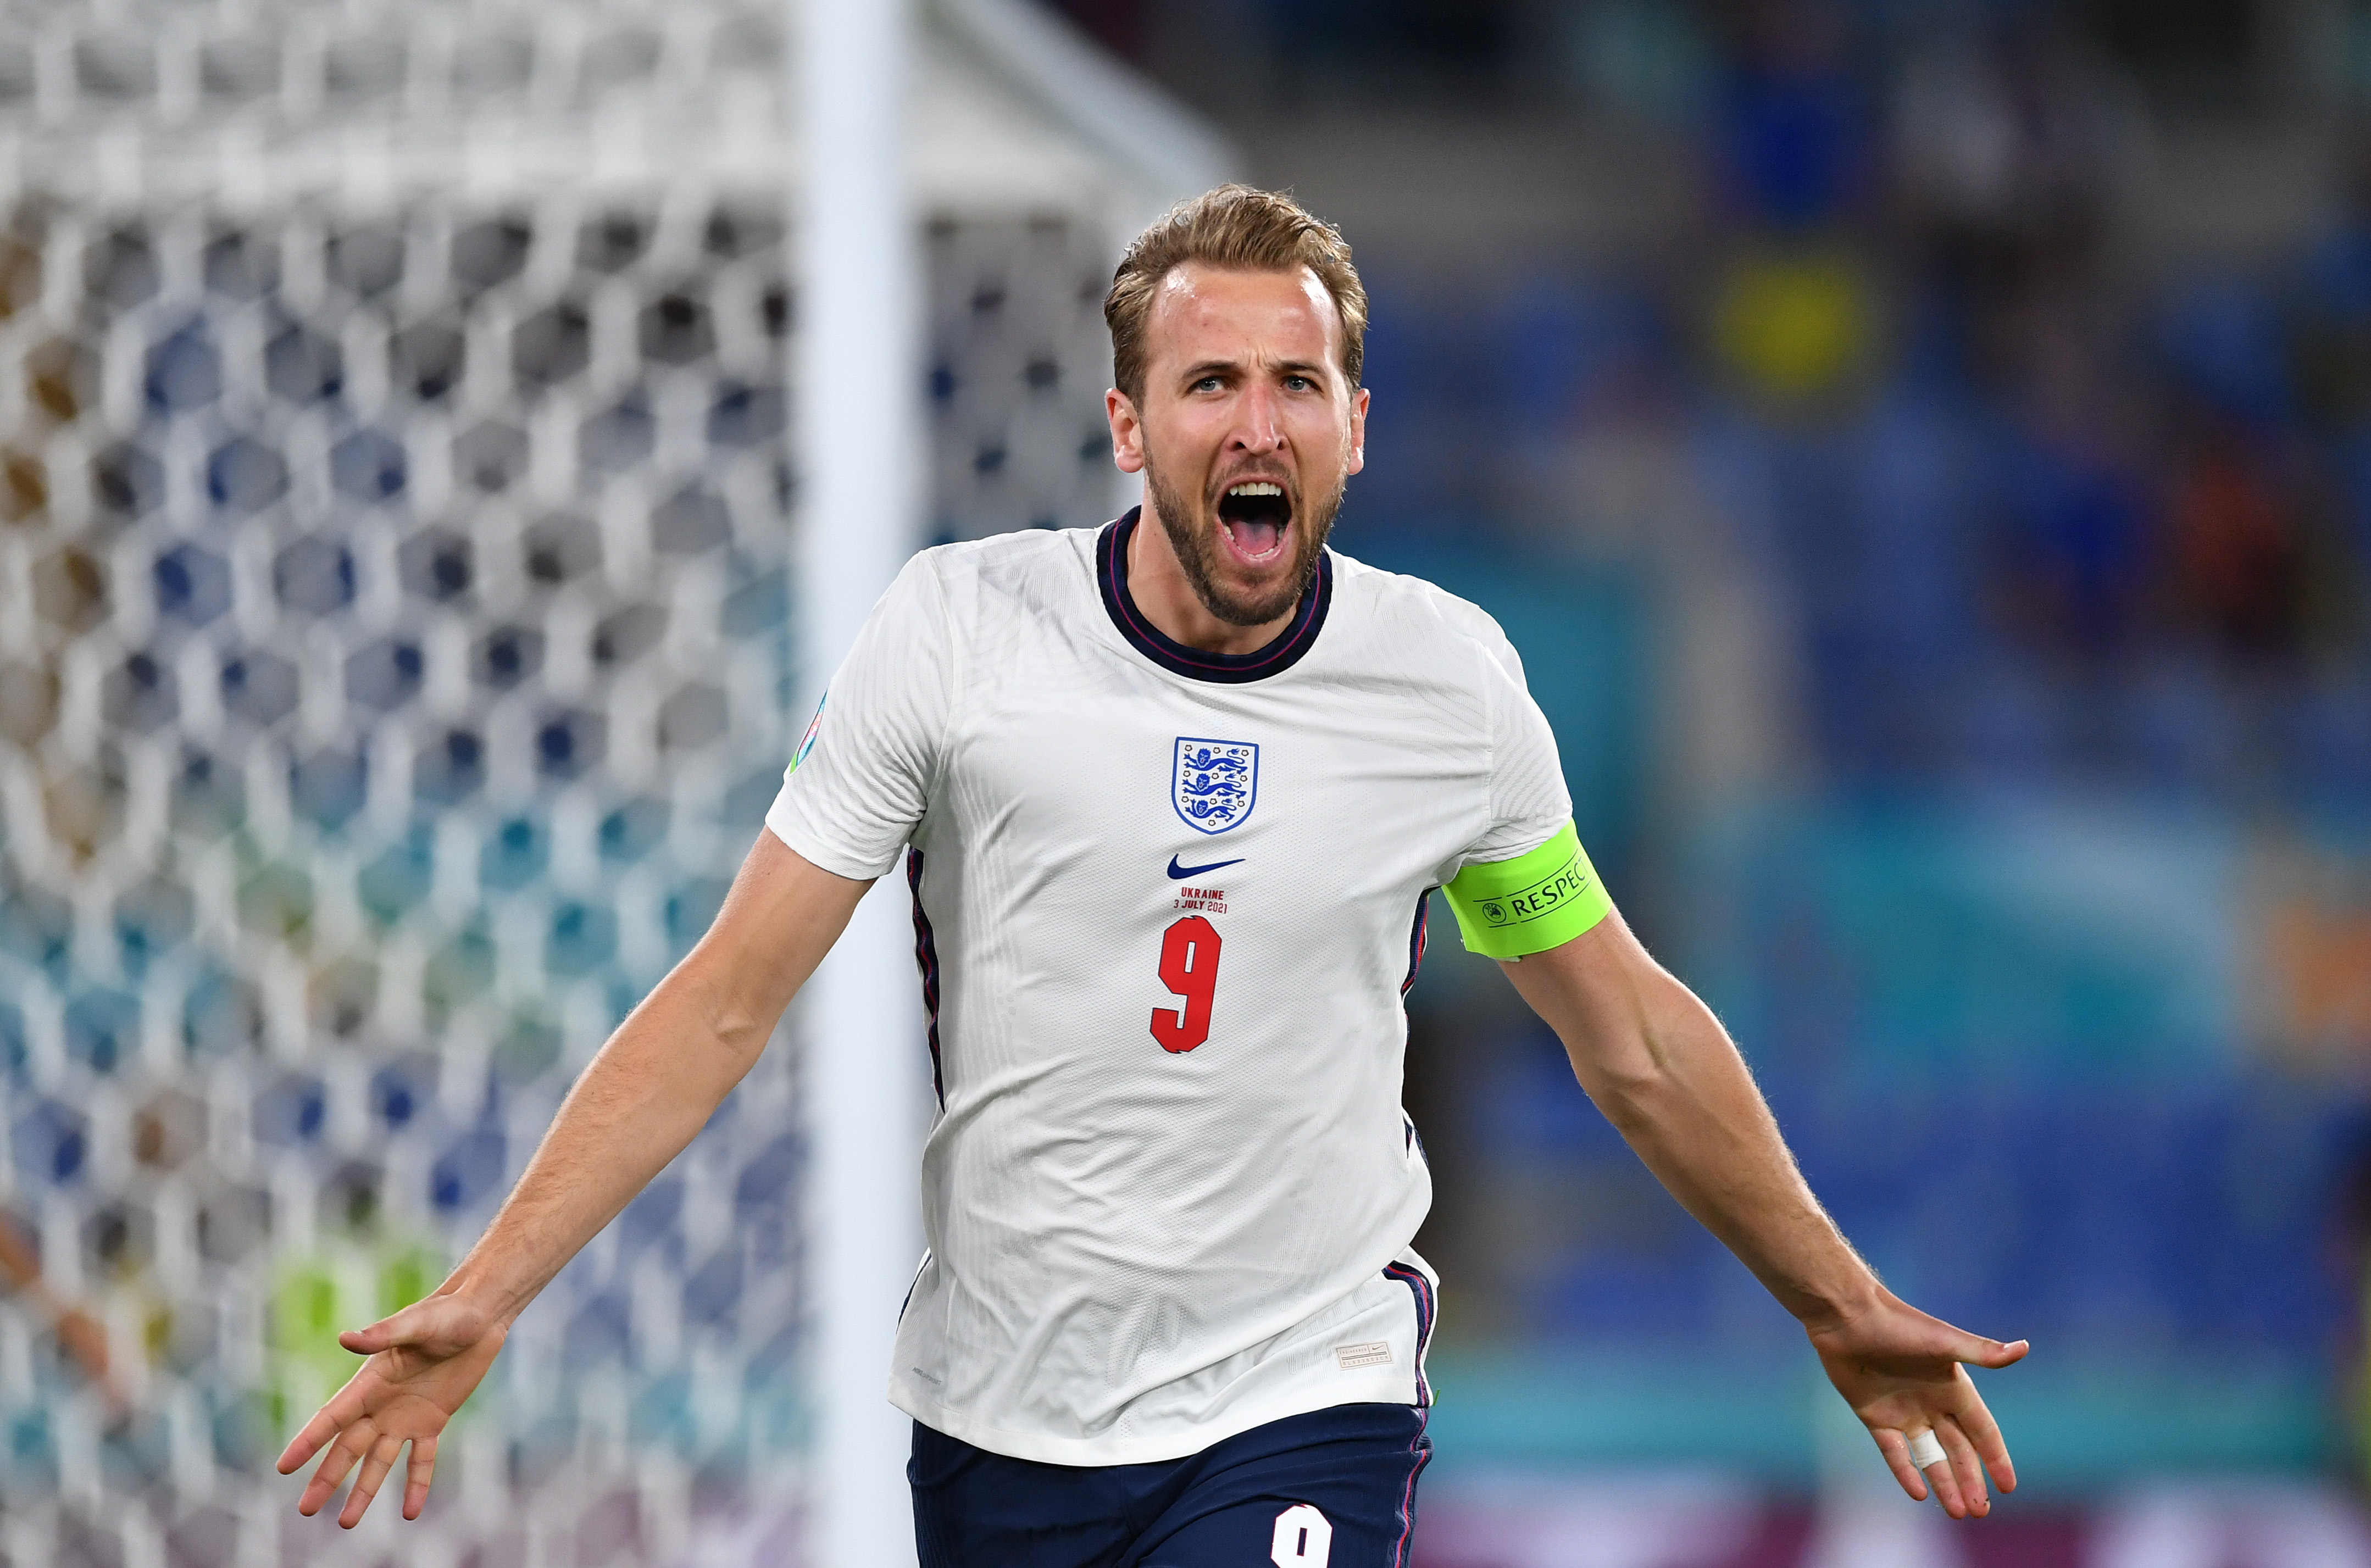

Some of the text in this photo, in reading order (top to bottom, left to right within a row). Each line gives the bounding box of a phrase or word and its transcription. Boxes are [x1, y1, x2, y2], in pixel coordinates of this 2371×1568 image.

[1181, 887, 1224, 900] UKRAINE
[1511, 856, 1588, 916] RESPECT
[1174, 899, 1228, 914] 3 JULY 2021
[1150, 915, 1222, 1054] 9
